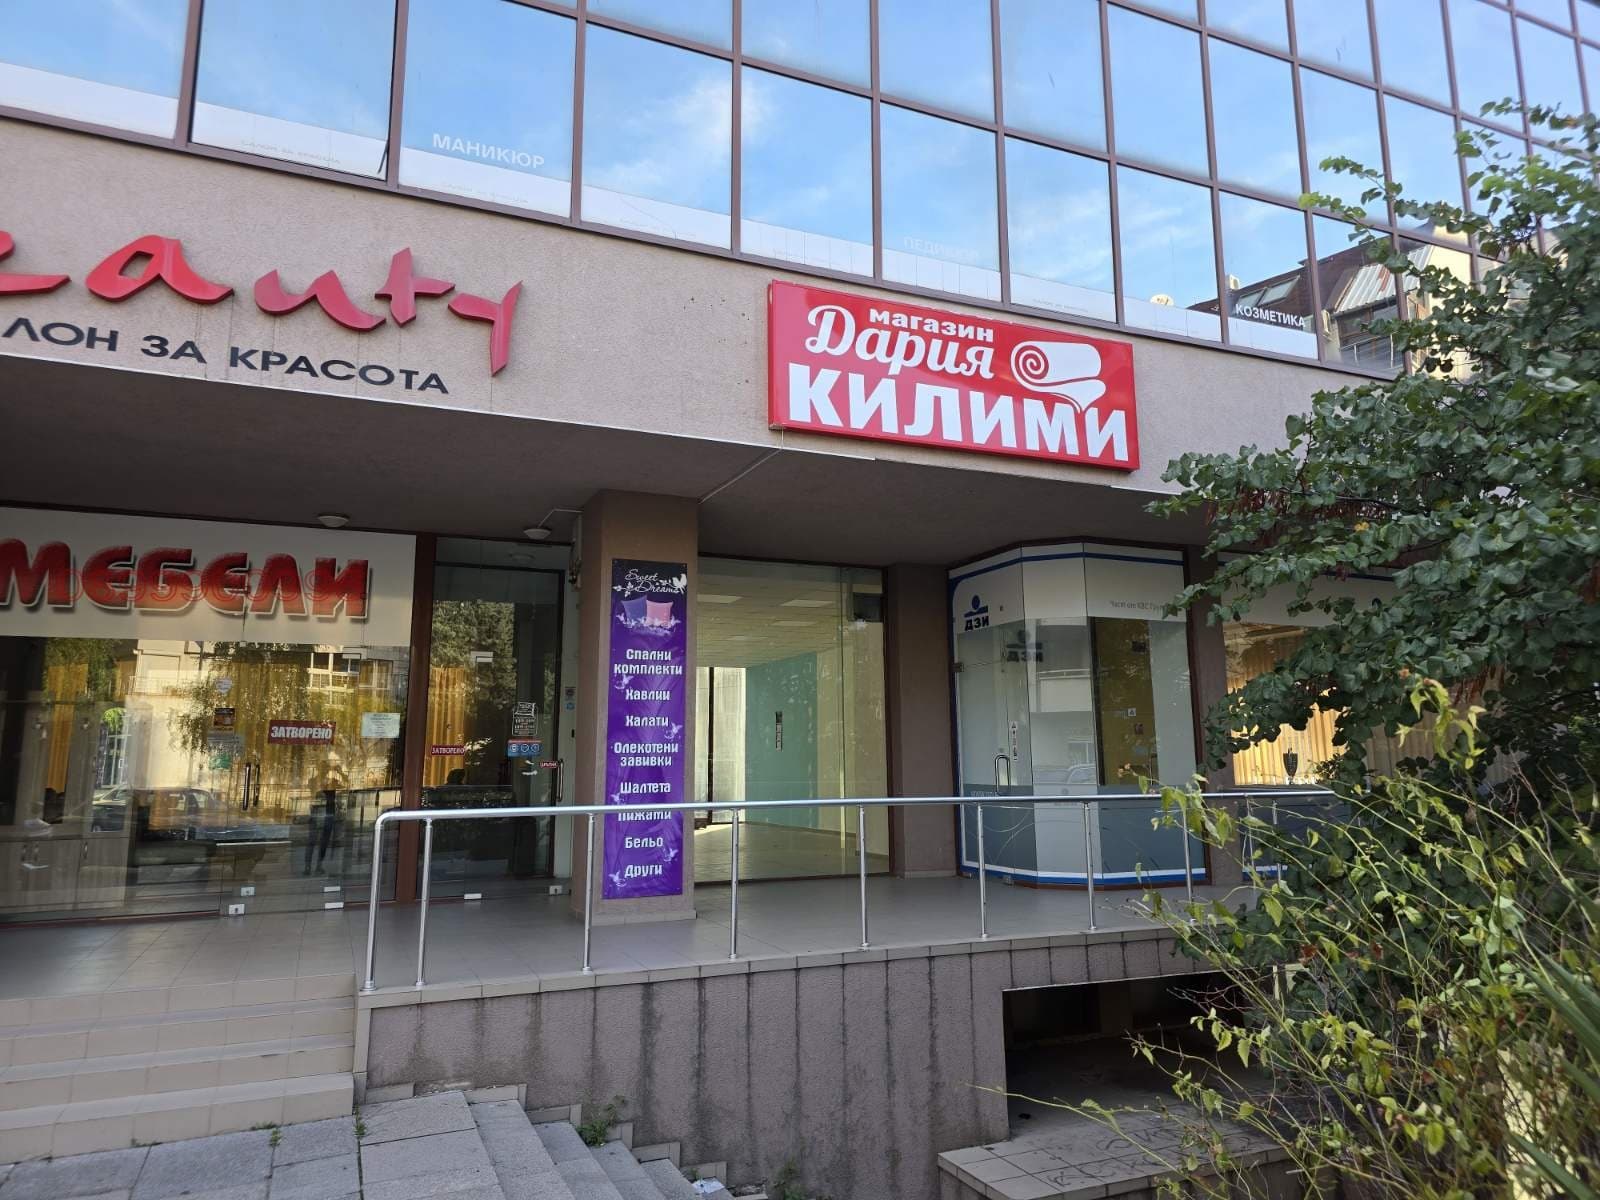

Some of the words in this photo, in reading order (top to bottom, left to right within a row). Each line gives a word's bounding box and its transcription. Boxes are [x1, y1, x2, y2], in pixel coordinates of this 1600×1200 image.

[432, 133, 545, 168] МАНИКЮР
[1236, 304, 1306, 328] КОЗМЕТИКА
[805, 304, 995, 379] Дария
[141, 335, 207, 364] ЗА
[230, 346, 449, 394] КРАСОТА
[788, 362, 1129, 462] КИЛИМИ
[625, 568, 659, 581] Sweet
[634, 580, 680, 593] Dreams
[965, 616, 989, 631] ДЗИ
[626, 649, 672, 661] Спални
[614, 663, 683, 675] комплекти
[625, 689, 670, 700] Хавлии
[625, 715, 669, 727] Халати
[271, 726, 333, 740] ЗАТВОРЕНО
[614, 742, 679, 754] Олекотени
[620, 756, 672, 767] завивки
[620, 782, 671, 794] Шалтета
[625, 837, 664, 849] Бельо
[624, 865, 663, 878] Други
